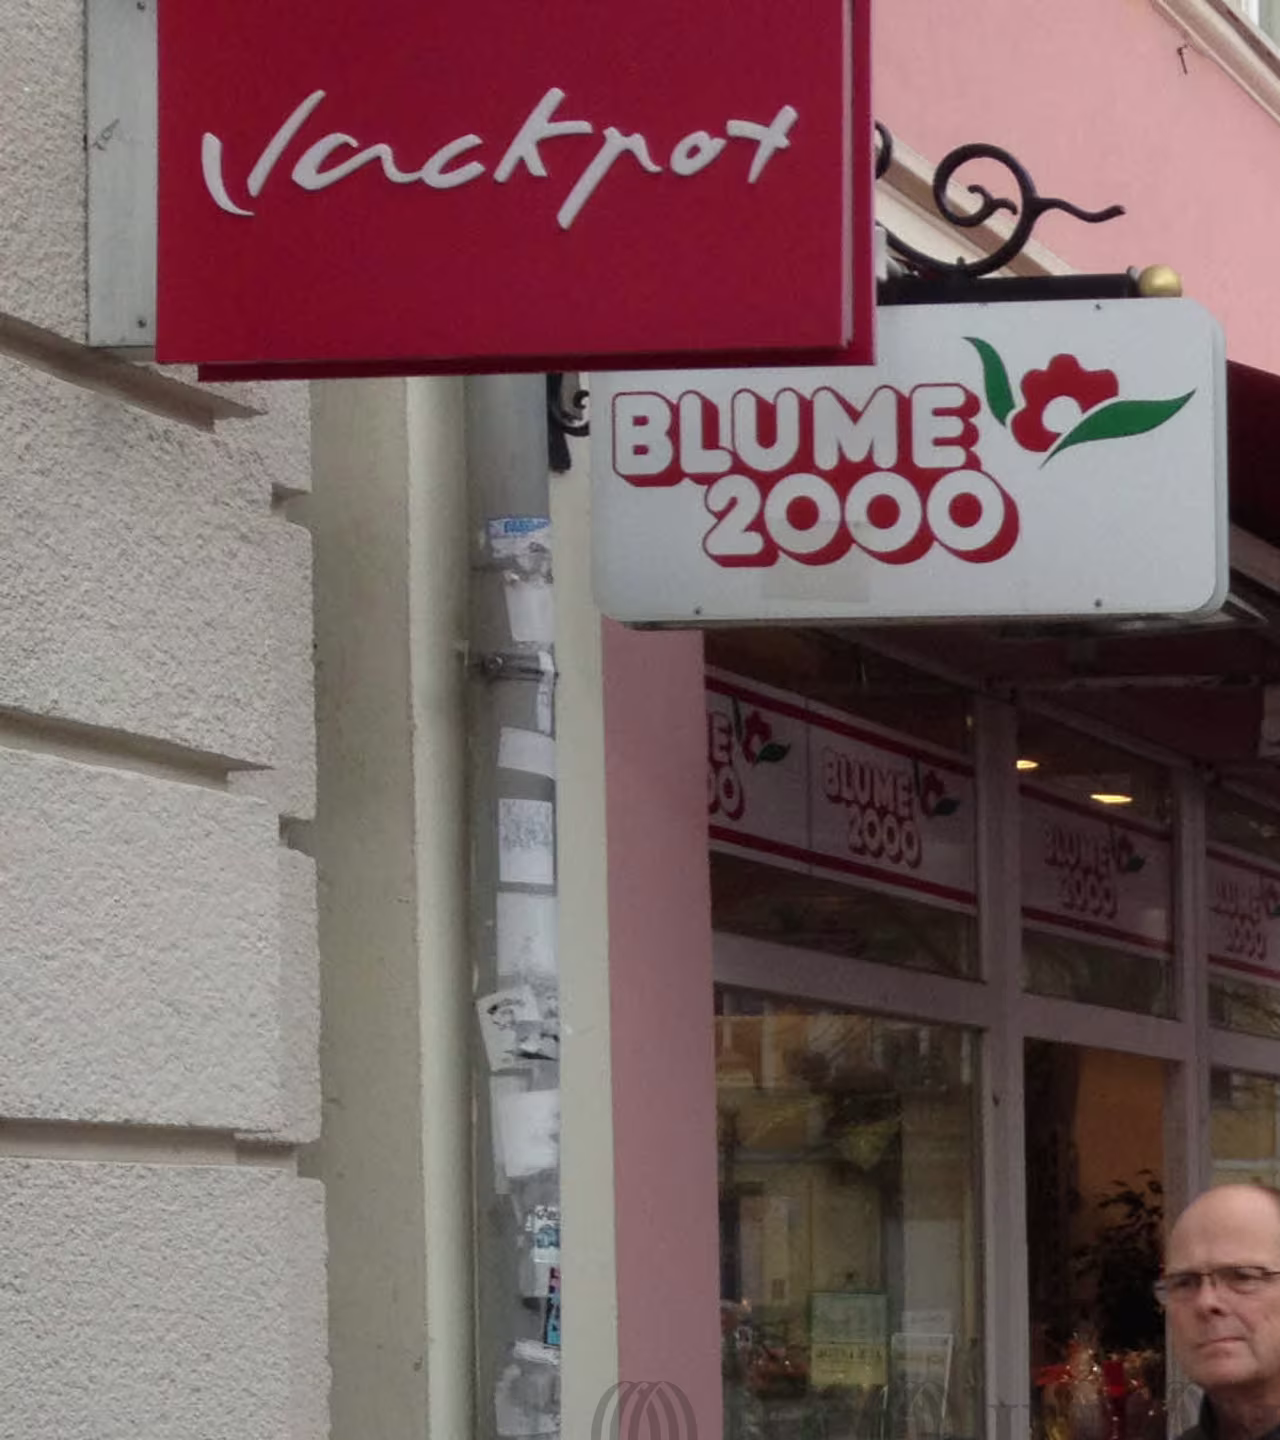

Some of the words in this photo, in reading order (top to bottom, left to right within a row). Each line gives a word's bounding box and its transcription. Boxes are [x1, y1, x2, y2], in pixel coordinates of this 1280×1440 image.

[611, 382, 982, 487] BLUME
[702, 469, 1020, 568] 2000
[822, 746, 915, 820] BLUME
[848, 803, 923, 869] 2000
